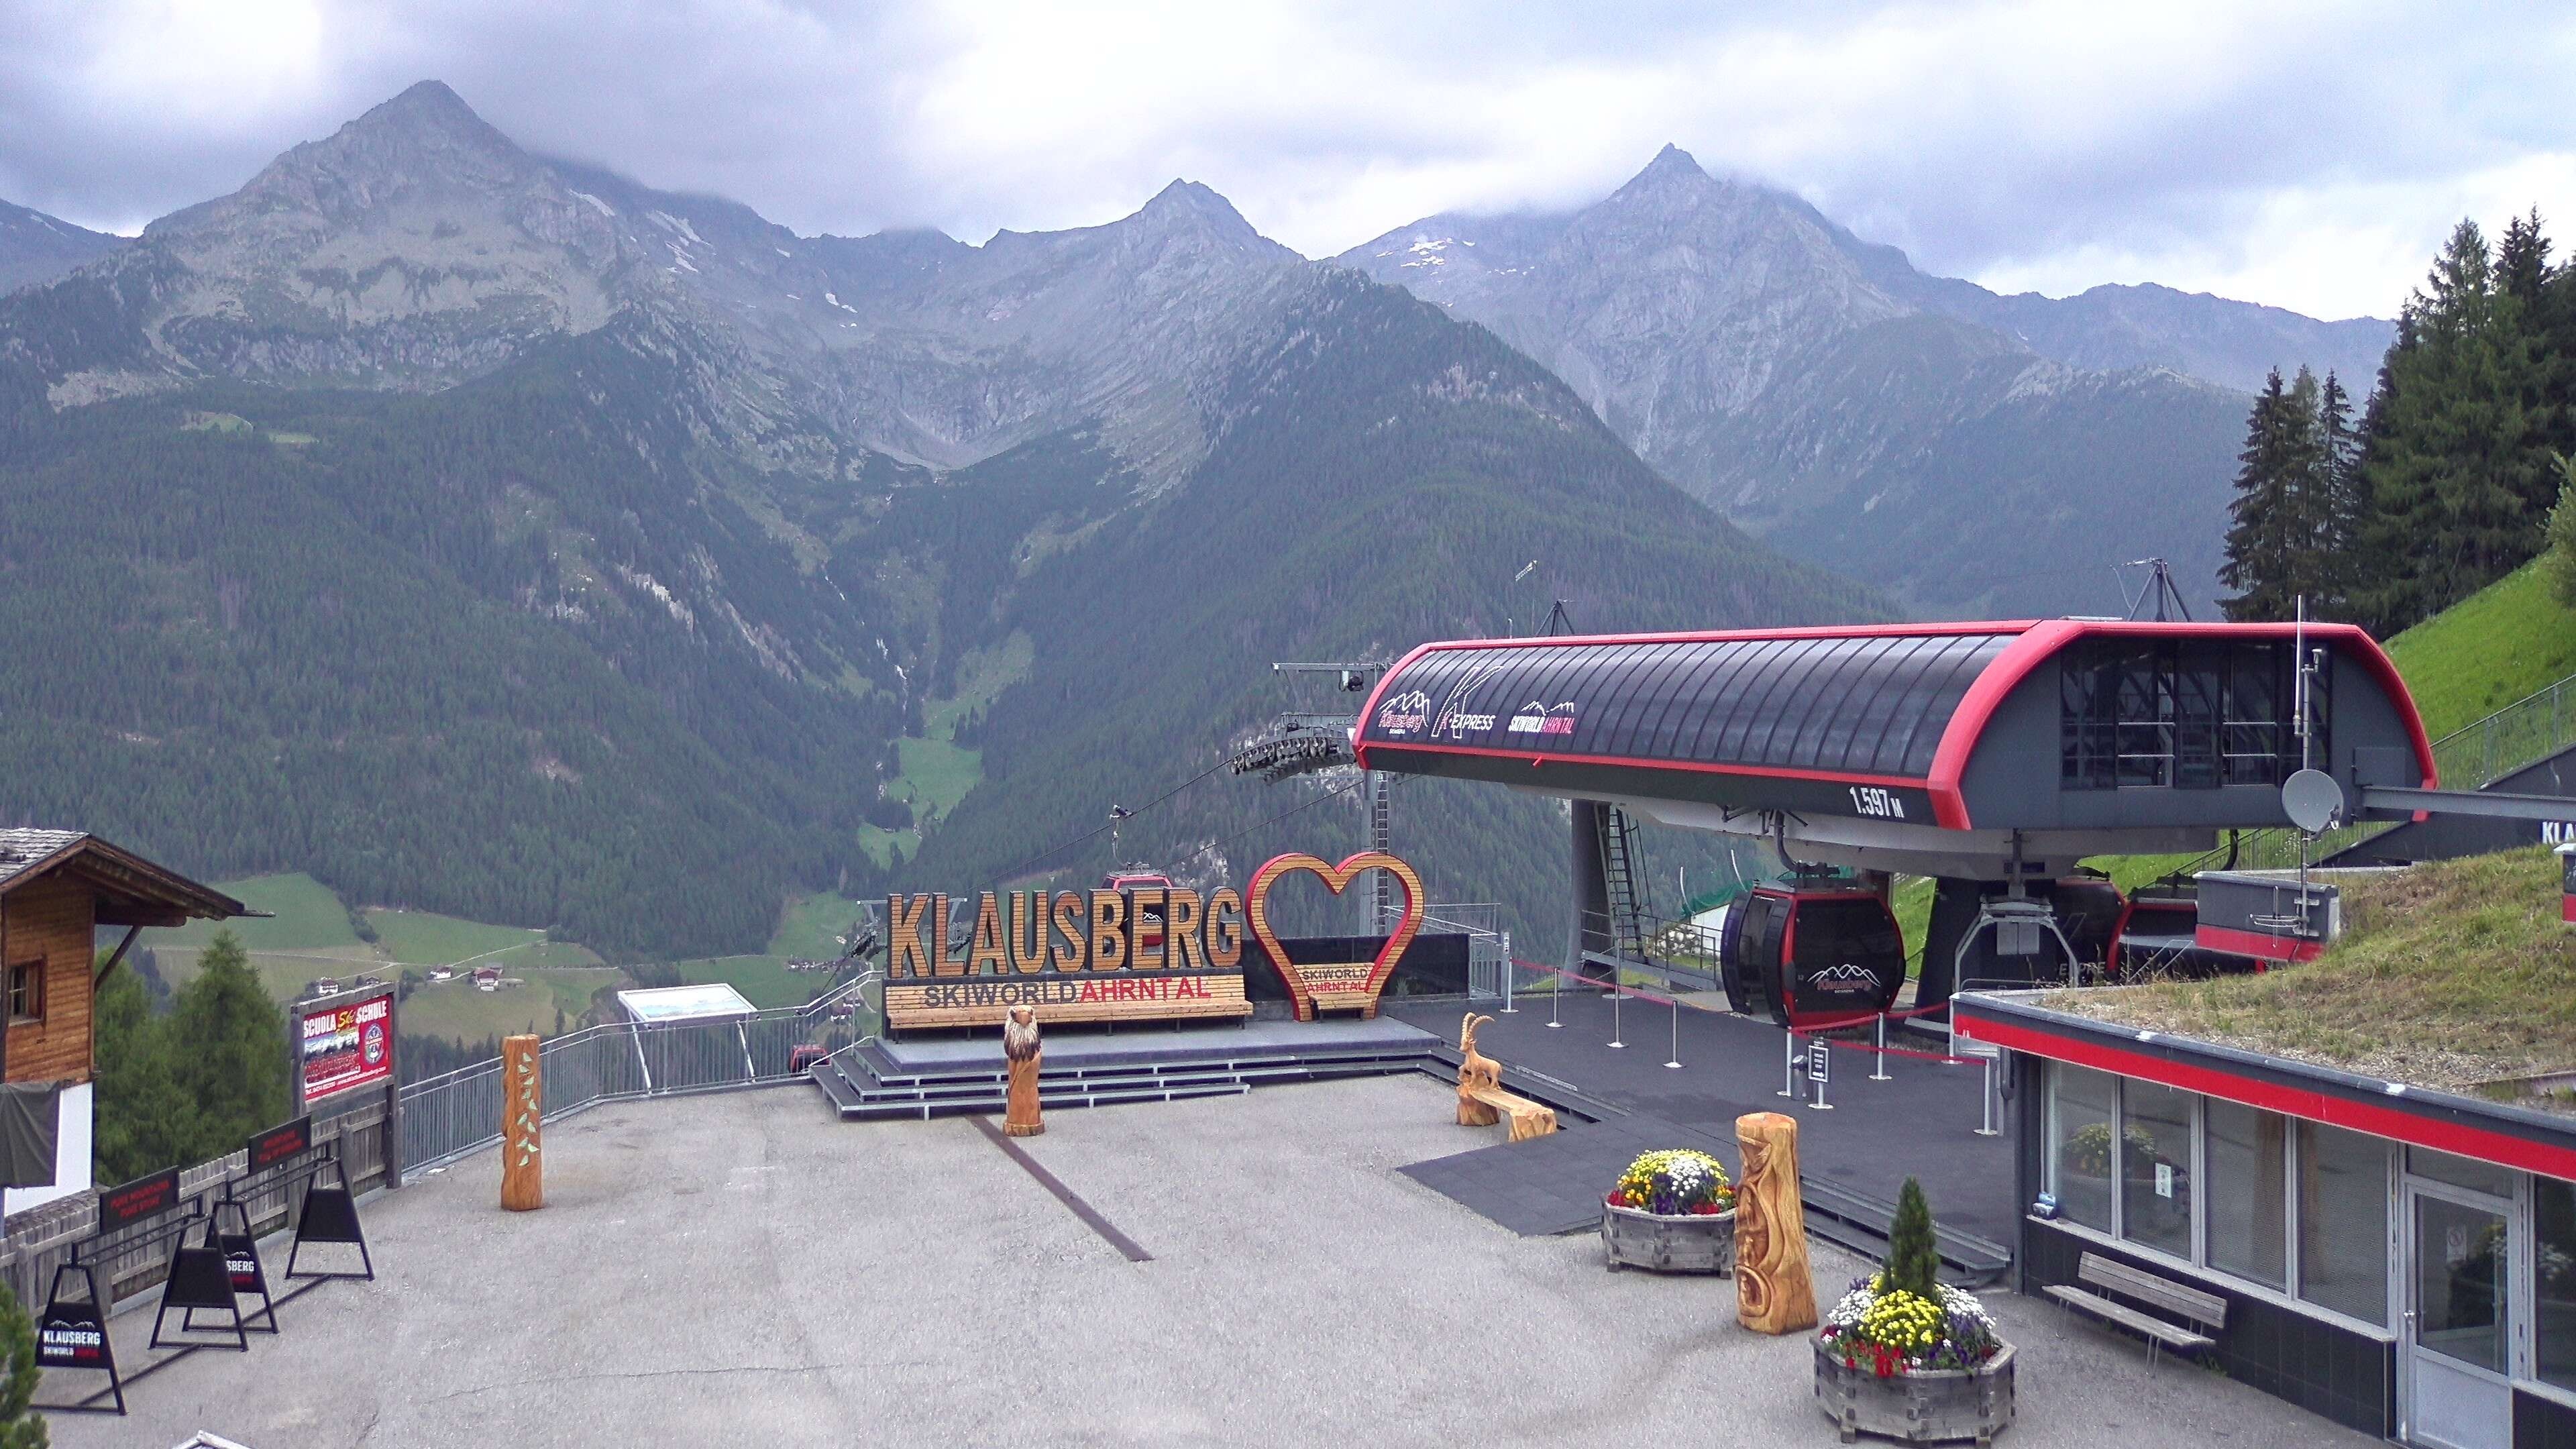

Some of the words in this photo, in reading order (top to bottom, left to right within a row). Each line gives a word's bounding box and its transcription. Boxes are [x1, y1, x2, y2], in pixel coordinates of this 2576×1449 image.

[1849, 787, 1890, 816] 1.597
[1890, 798, 1904, 818] M
[2542, 821, 2576, 844] KLA
[888, 886, 1242, 978] KLAUSBERG
[1302, 968, 1368, 980] SKIWORLD
[1307, 981, 1365, 992] AHRNTAL
[303, 1013, 337, 1038] SCUOLA
[337, 1009, 356, 1028] Ski
[356, 1000, 387, 1024] SCHULE
[43, 1330, 101, 1346] KLAUSBERG
